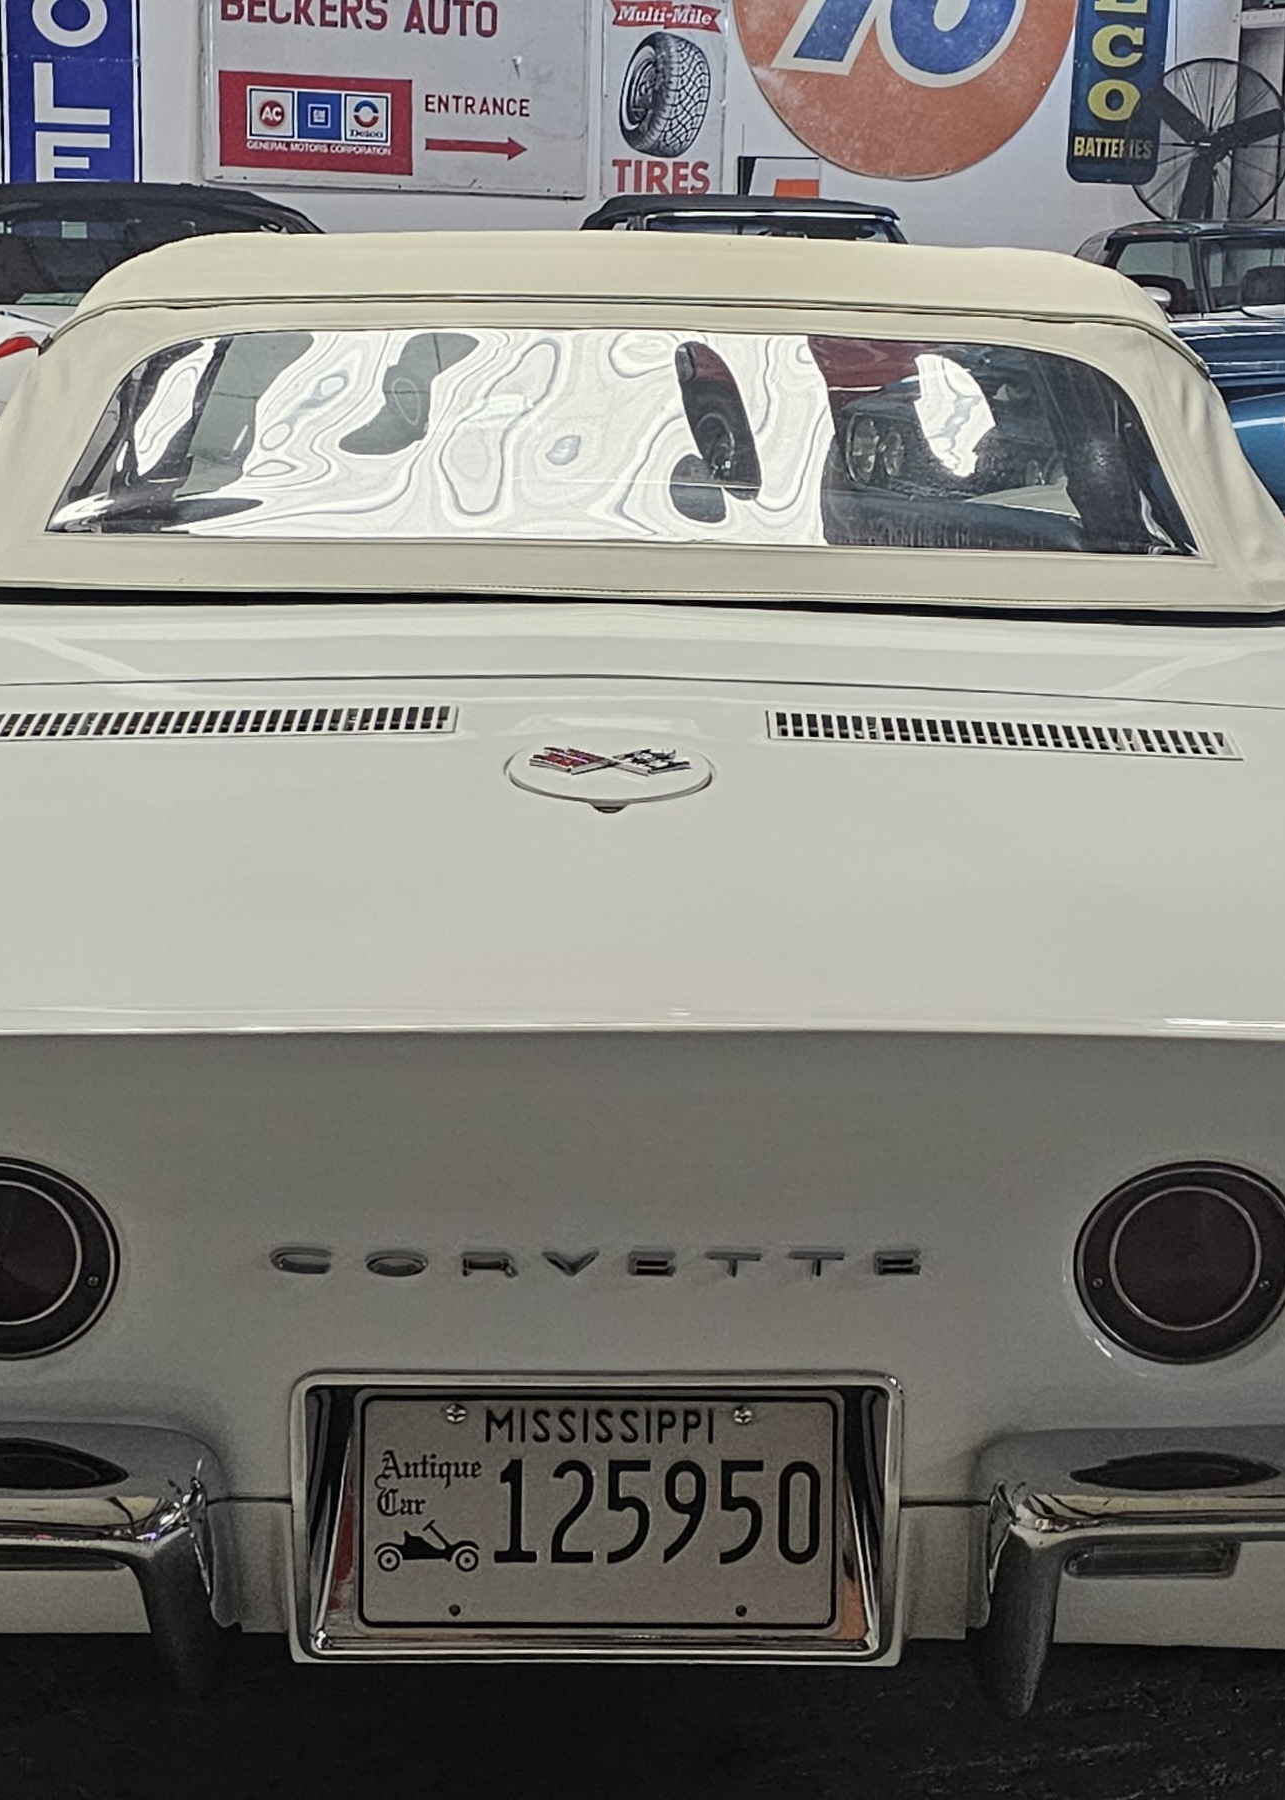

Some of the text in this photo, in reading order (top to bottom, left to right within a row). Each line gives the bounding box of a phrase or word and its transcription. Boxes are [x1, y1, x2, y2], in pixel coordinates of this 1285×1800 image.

[219, 0, 499, 37] BECKERS AUTO
[617, 5, 713, 26] Multi-Mile
[261, 106, 283, 121] AC
[424, 94, 531, 118] ENTRANCE
[246, 140, 392, 156] GENERAL MOTORS CORPORATION
[349, 129, 384, 139] Delco
[612, 159, 711, 195] TIRES
[269, 1245, 922, 1278] CORVETTE
[484, 1408, 716, 1445] MISSISSIPPI
[378, 1449, 483, 1489] Antique
[375, 1477, 426, 1516] Car
[493, 1457, 822, 1565] 125950
